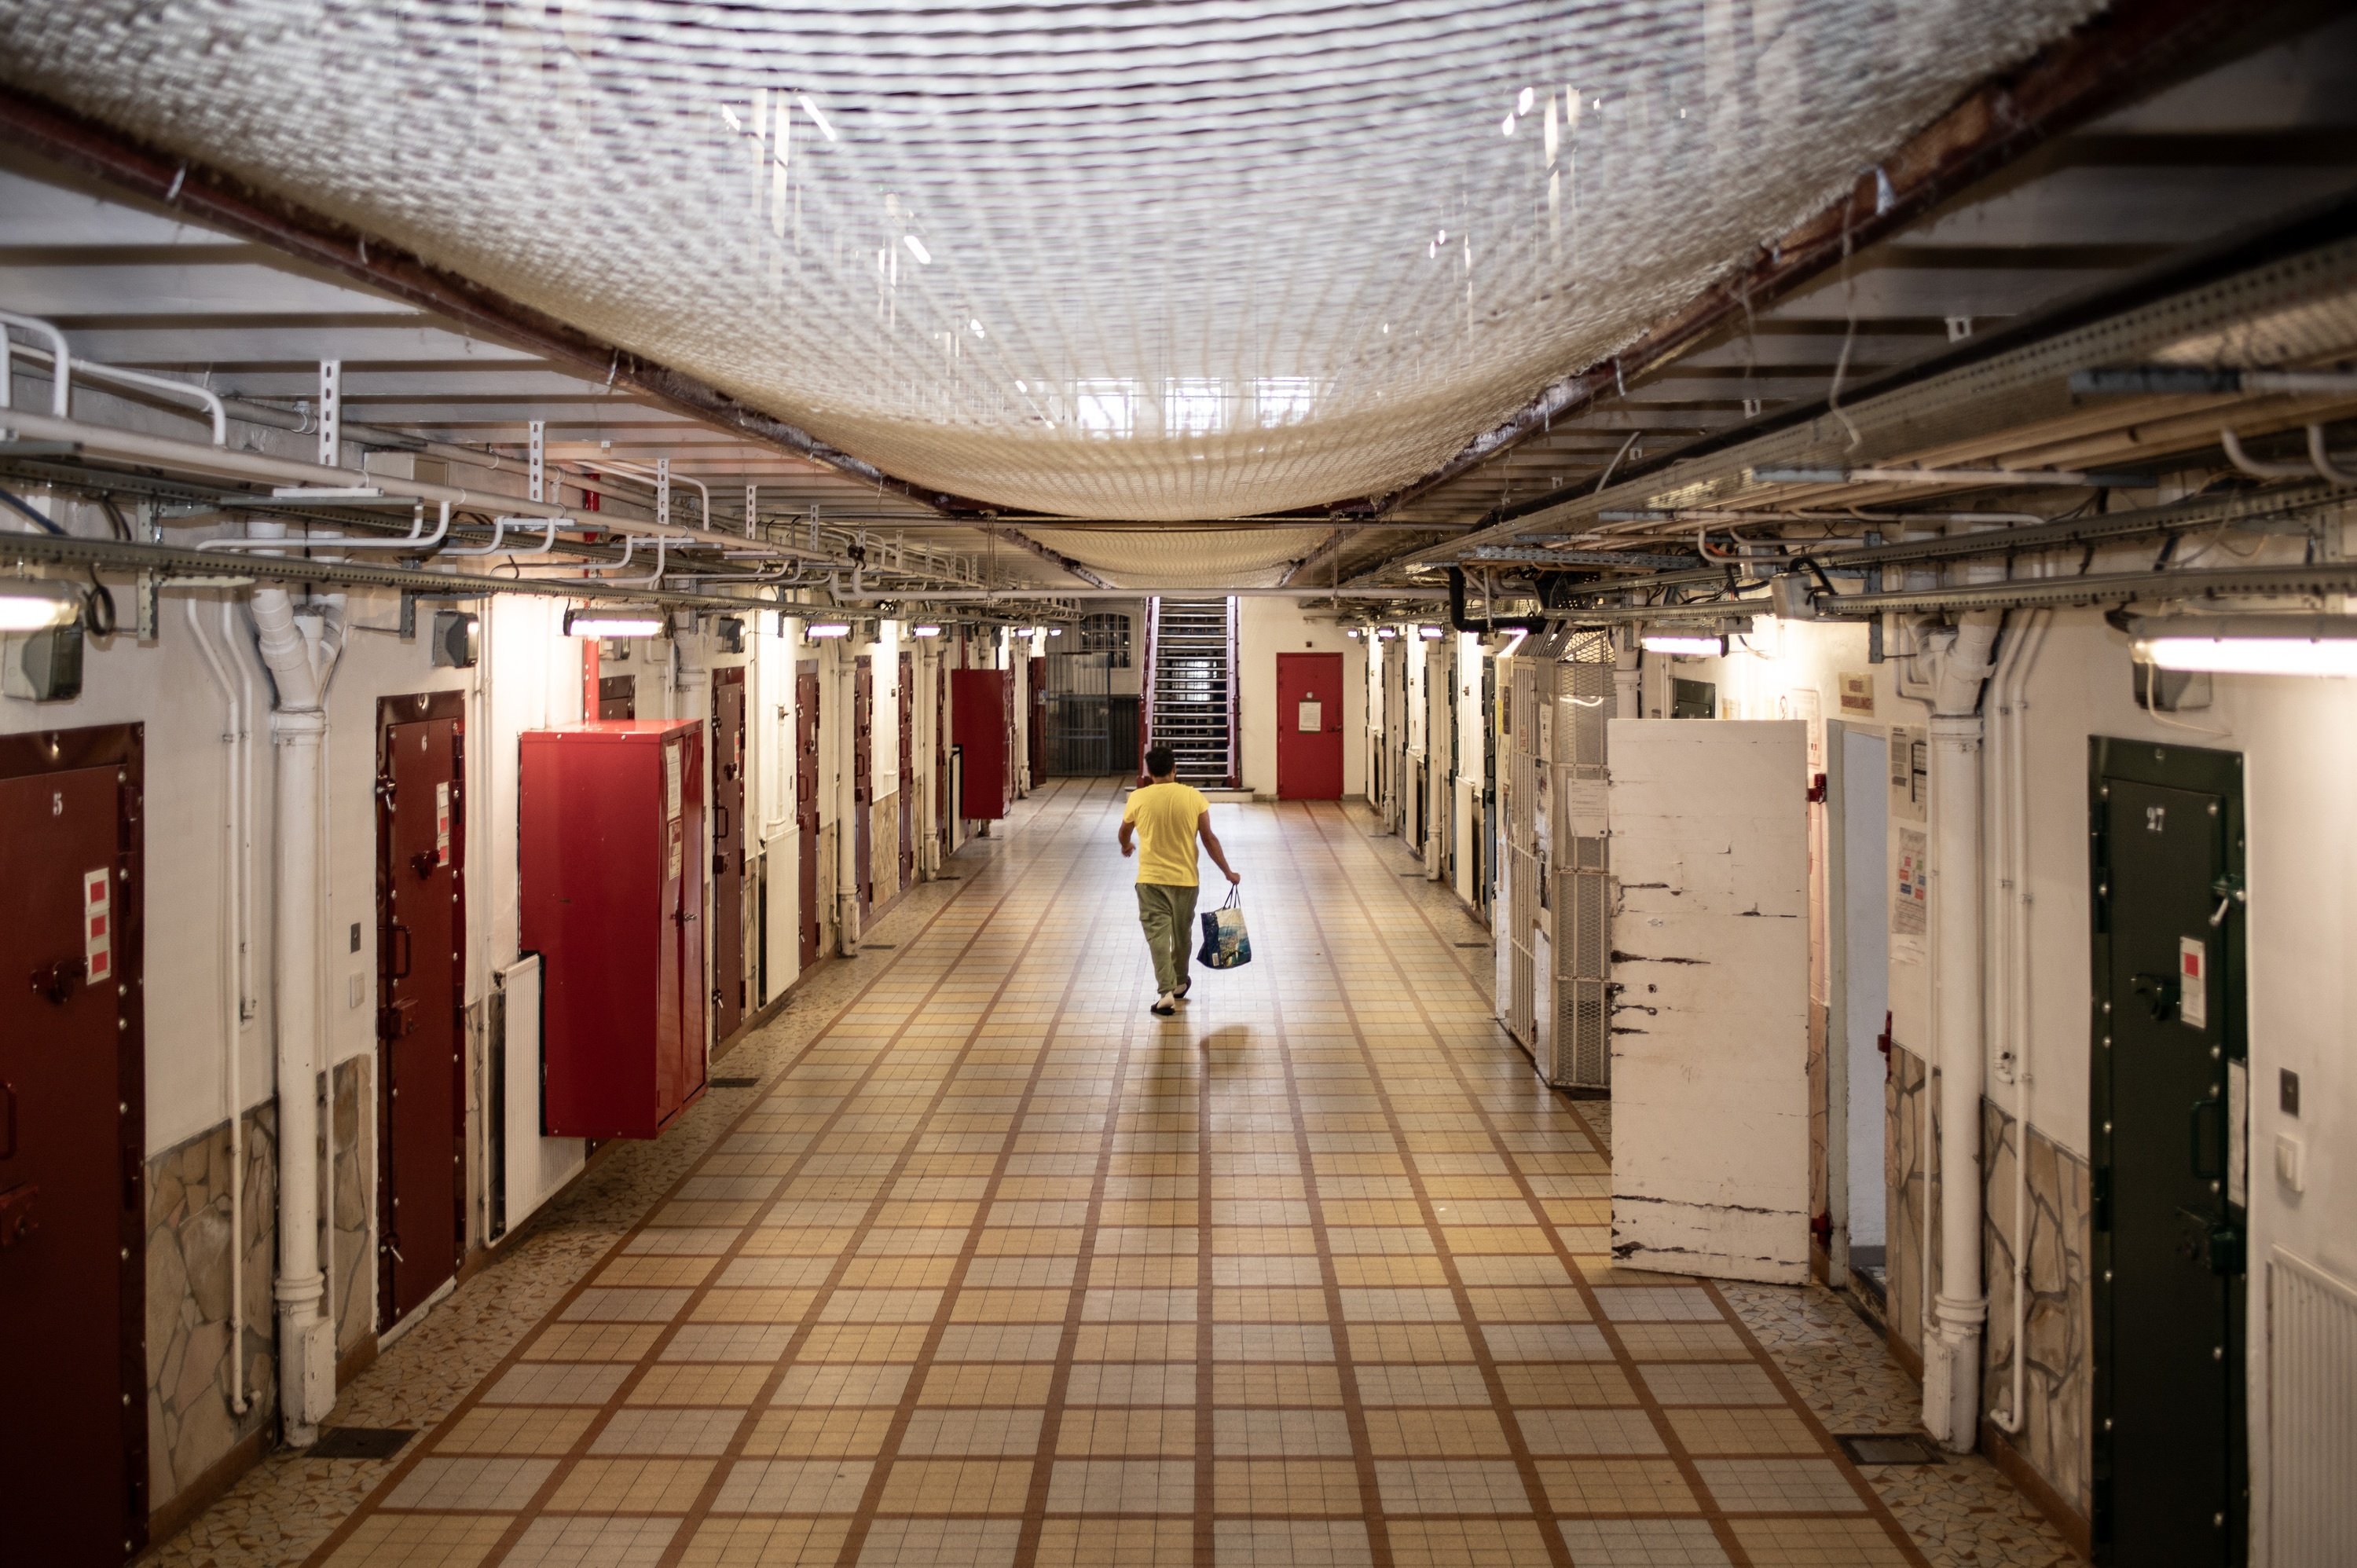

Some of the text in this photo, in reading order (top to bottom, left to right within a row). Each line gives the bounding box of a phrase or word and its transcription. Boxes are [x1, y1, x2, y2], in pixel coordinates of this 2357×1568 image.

[422, 735, 427, 752] 6
[53, 793, 63, 815] 5
[2146, 807, 2165, 831] 27
